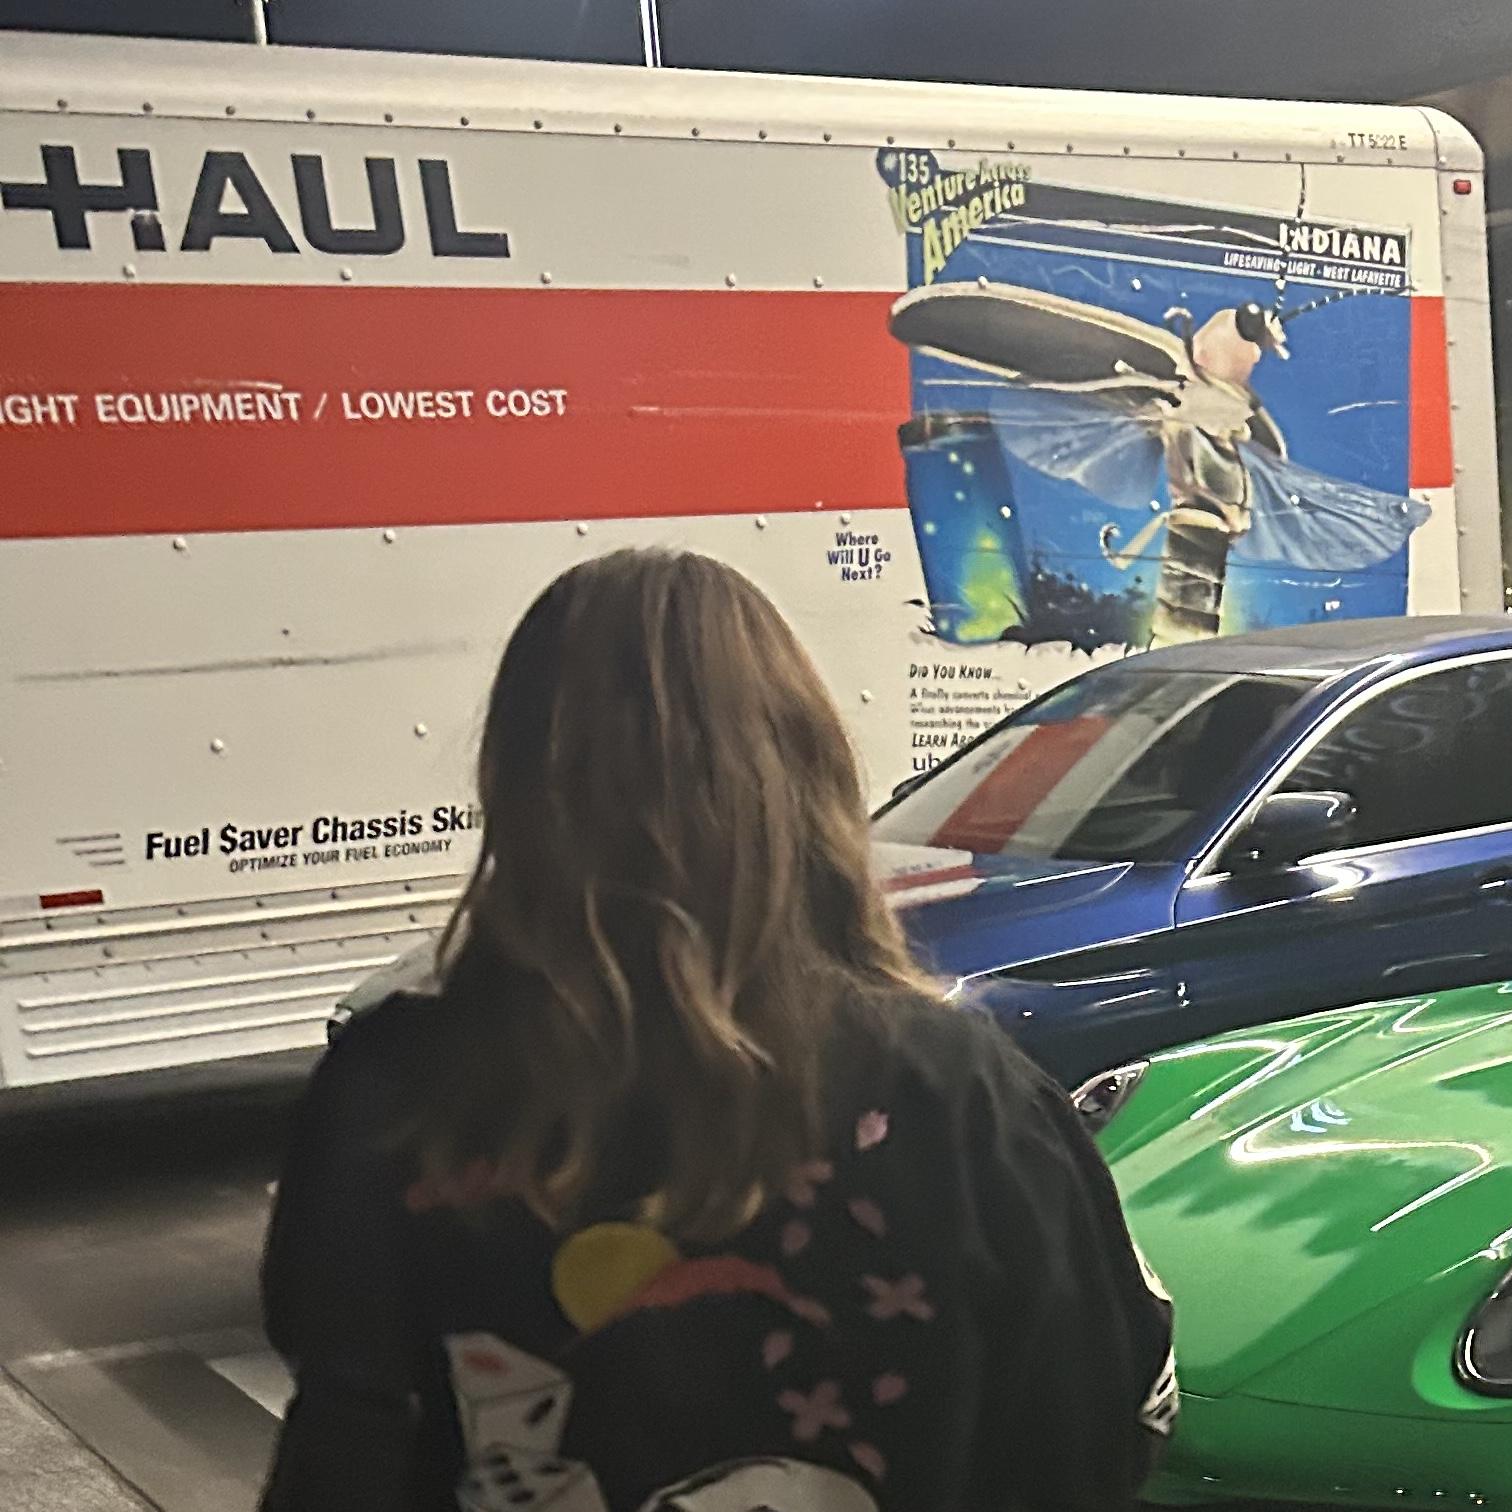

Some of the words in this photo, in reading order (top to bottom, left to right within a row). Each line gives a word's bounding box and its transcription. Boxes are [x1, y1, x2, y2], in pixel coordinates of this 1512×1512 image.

[888, 168, 977, 236] Venture
[923, 181, 1026, 285] America
[1279, 223, 1401, 264] INDIANA
[1287, 261, 1316, 277] LIGHT
[1323, 265, 1350, 281] WEST
[1351, 269, 1401, 289] LAFAYETTE
[95, 392, 302, 422] EQUIPMENT
[341, 391, 474, 419] LOWEST
[486, 389, 568, 417] COST
[836, 531, 878, 547] Where
[827, 548, 853, 565] Will
[858, 548, 869, 567] U
[874, 548, 891, 562] Go
[842, 564, 882, 581] Next?
[145, 828, 209, 861] Fuel
[219, 822, 303, 855] $aver
[311, 810, 423, 844] Chassis
[229, 853, 298, 874] OPTIMIZE
[303, 849, 339, 866] YOUR
[345, 845, 377, 861] FUEL
[384, 838, 452, 858] ECONOMY
